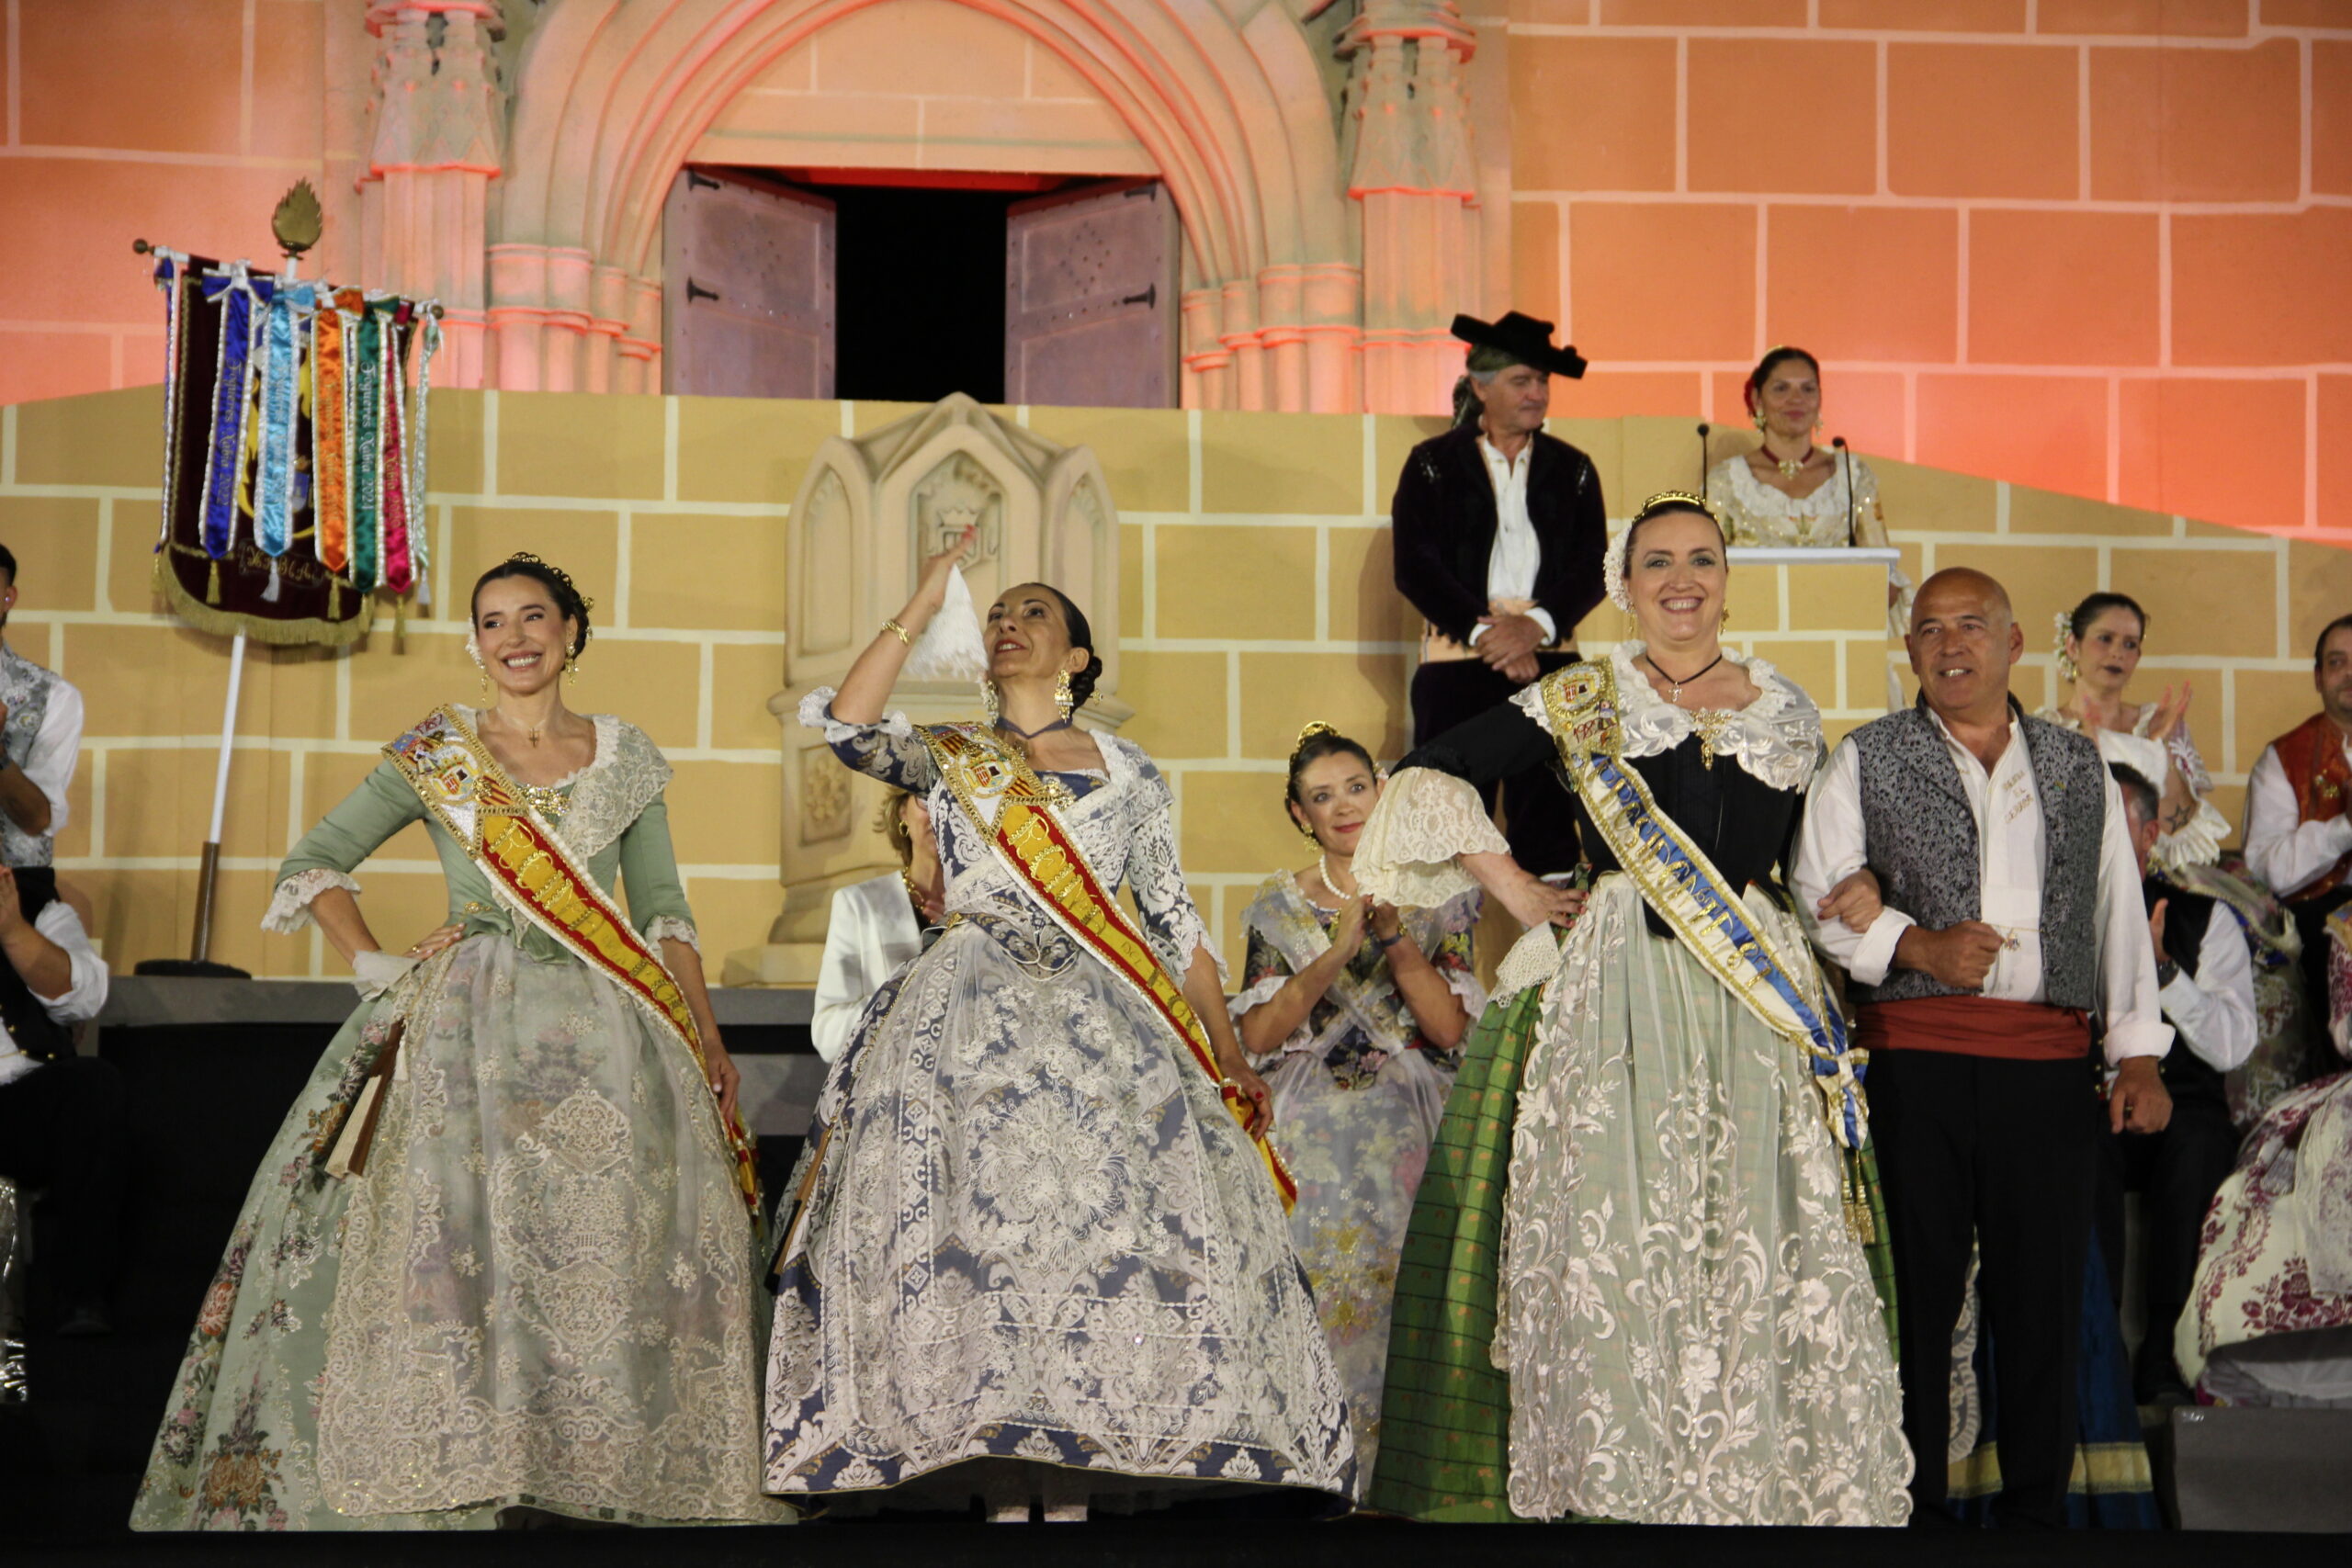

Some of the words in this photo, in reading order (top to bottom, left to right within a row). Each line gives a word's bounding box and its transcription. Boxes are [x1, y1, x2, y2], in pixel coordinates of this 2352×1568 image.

[222, 358, 242, 423] Fogueres
[359, 361, 377, 428] Fogueres
[488, 818, 605, 940] REINA
[1007, 813, 1106, 935] REINA
[1586, 759, 1734, 948] PRESIDENTA
[1727, 942, 1772, 989] 87
